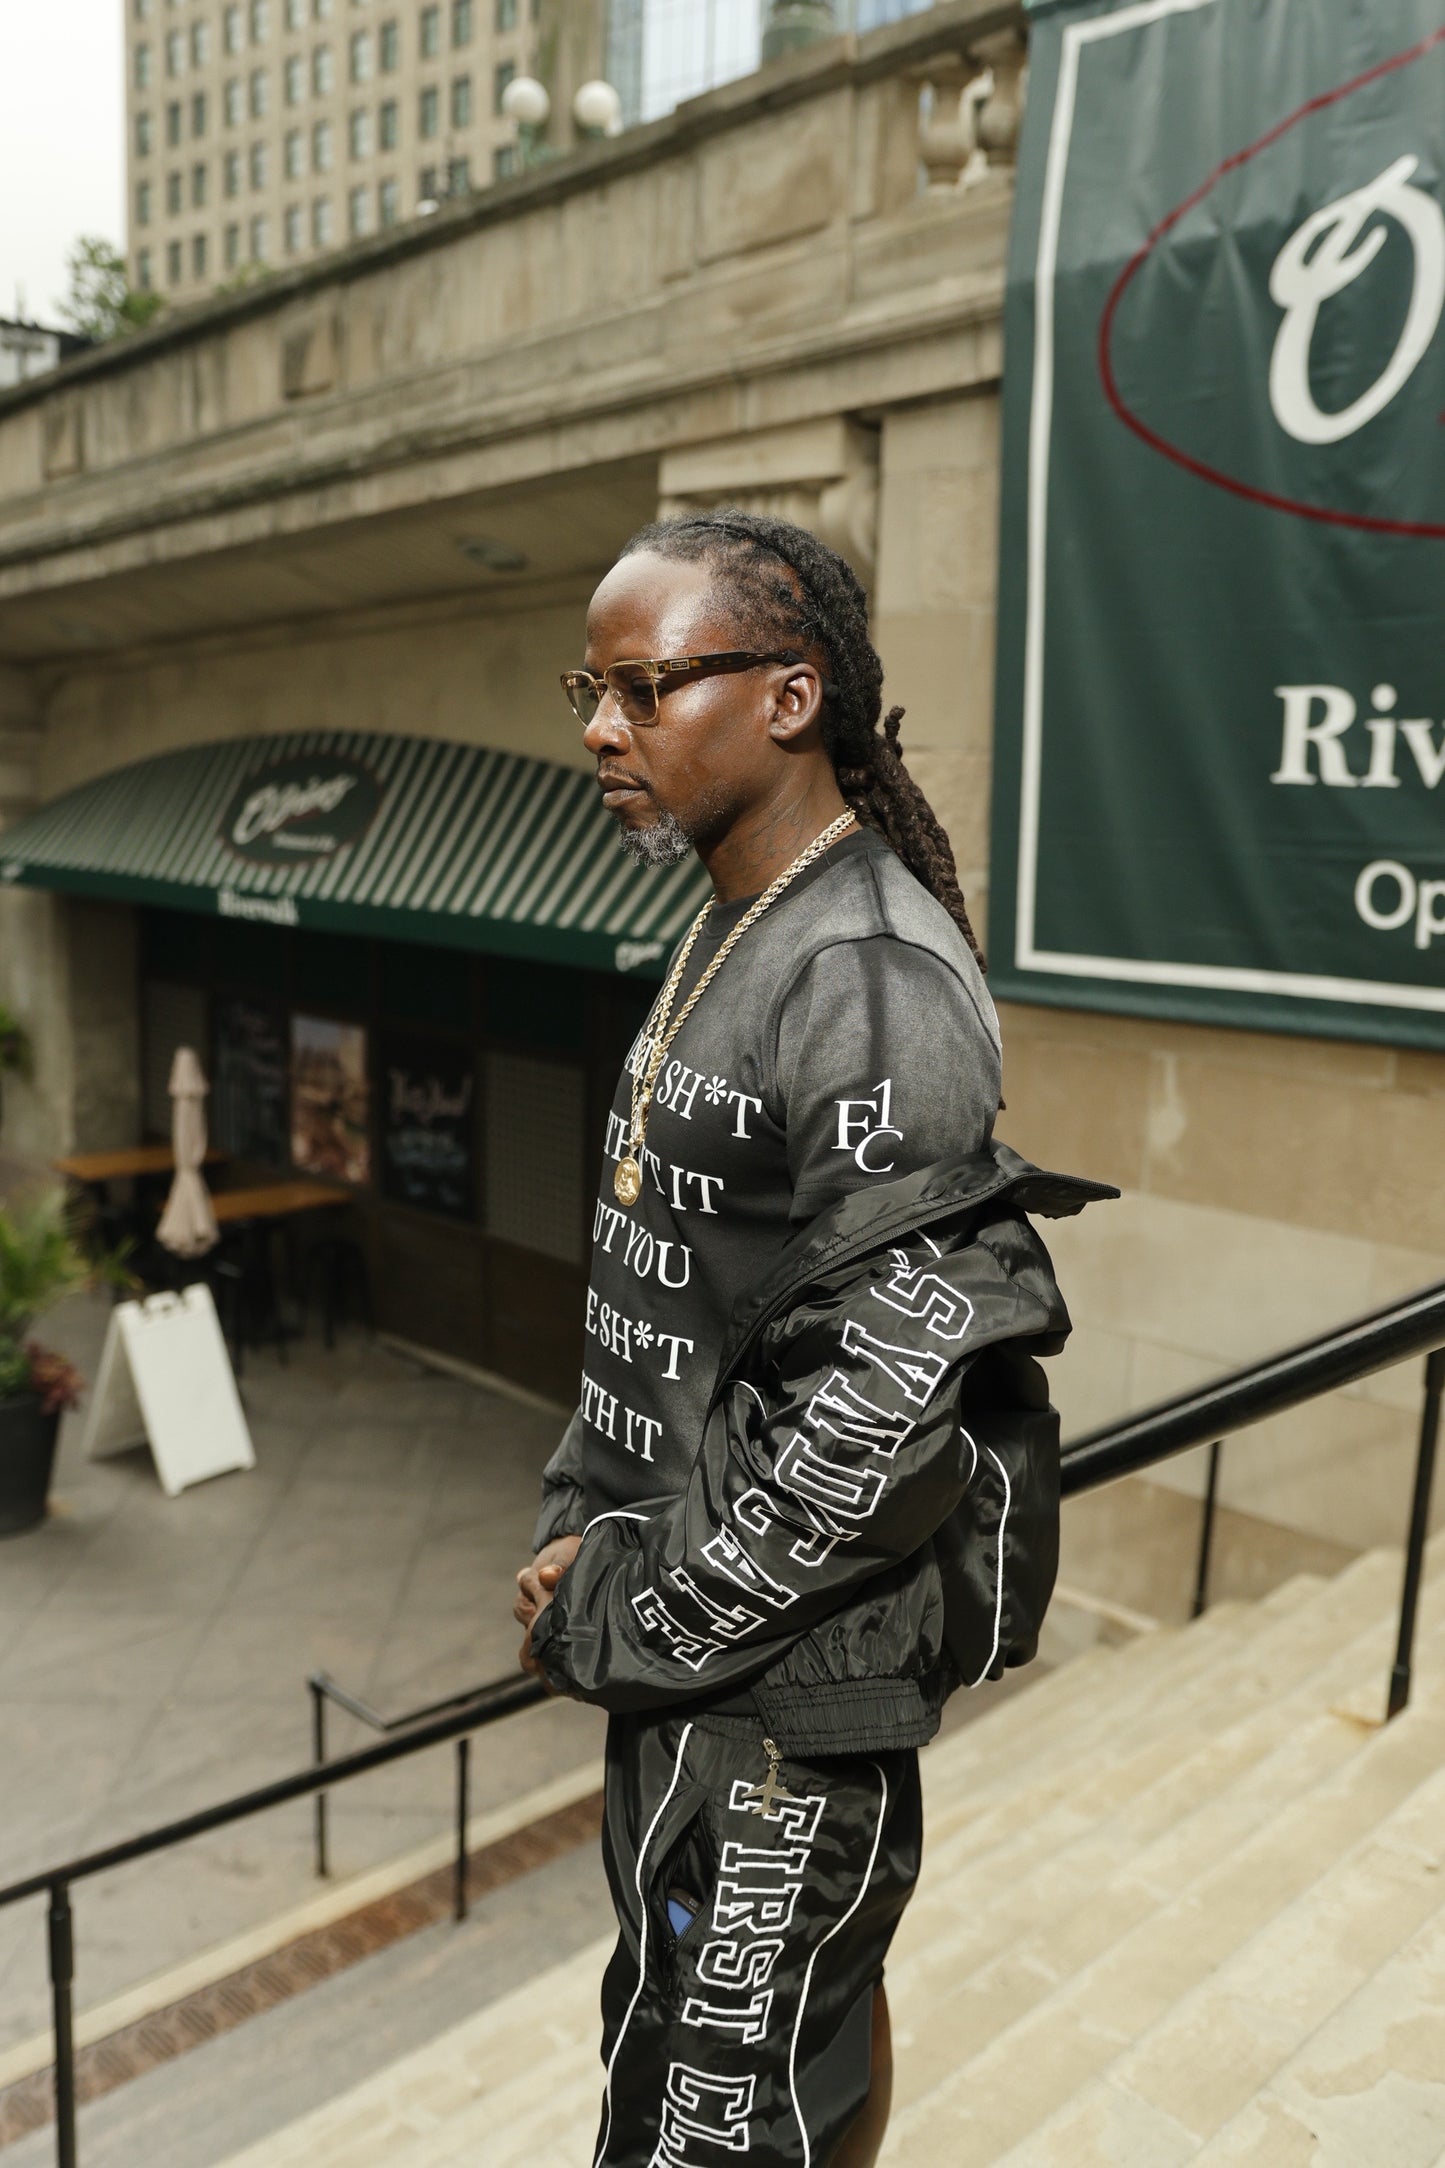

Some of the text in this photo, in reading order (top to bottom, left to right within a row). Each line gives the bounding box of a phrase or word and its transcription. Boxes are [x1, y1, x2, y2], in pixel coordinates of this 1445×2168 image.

[669, 1164, 724, 1214] IT
[623, 1219, 693, 1289] YOU
[624, 1407, 662, 1462] IT
[681, 1780, 827, 2045] FIRST
